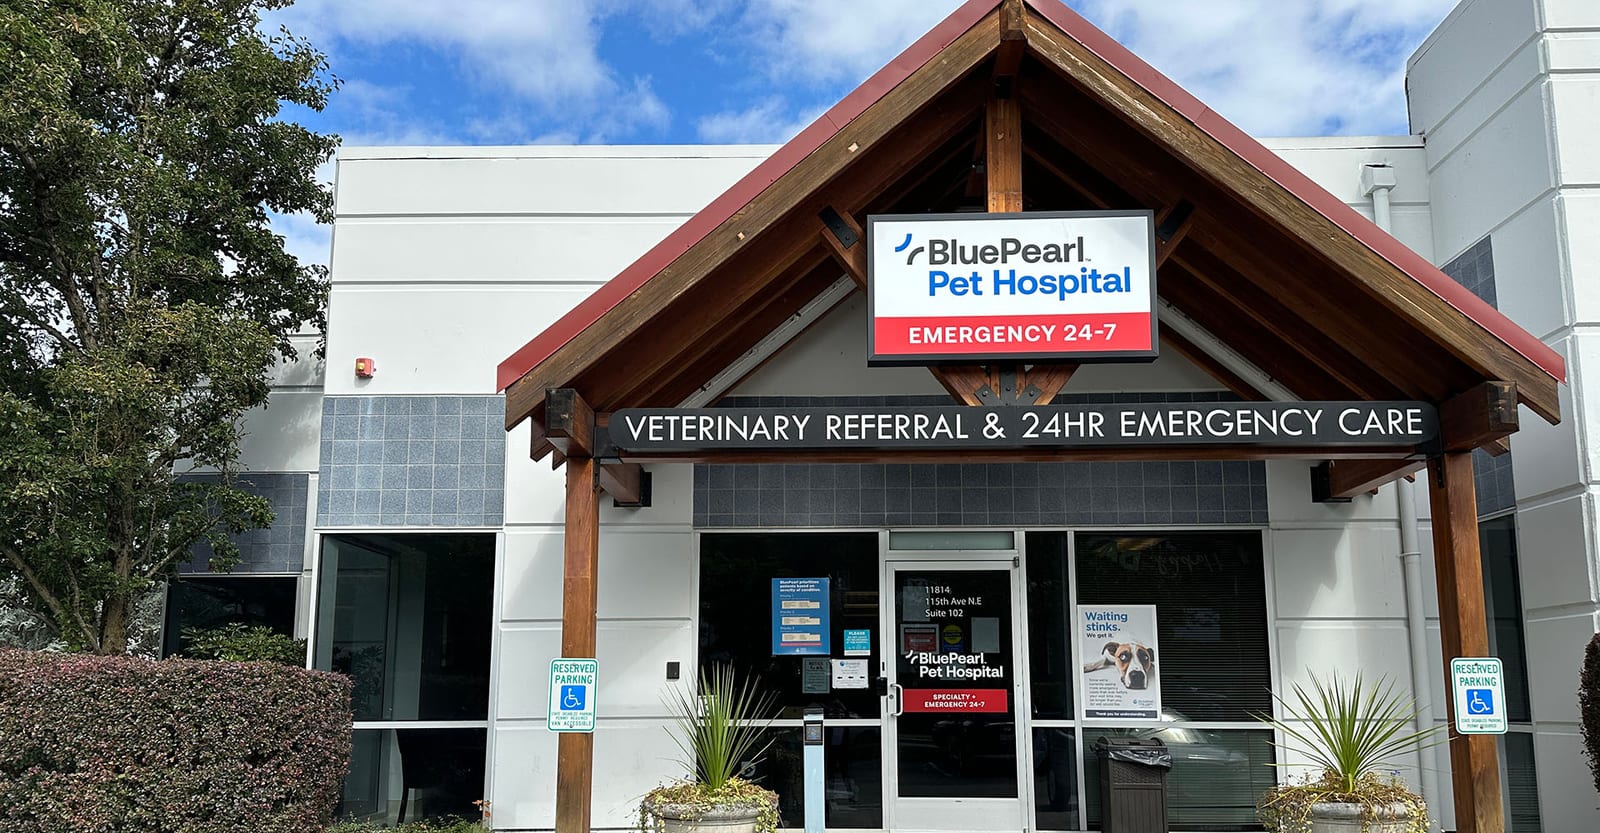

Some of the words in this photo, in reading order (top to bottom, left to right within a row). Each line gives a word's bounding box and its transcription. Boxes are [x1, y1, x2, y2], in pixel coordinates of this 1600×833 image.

[929, 236, 1084, 265] BluePearl
[929, 271, 983, 297] Pet
[993, 266, 1131, 301] Hospital
[909, 324, 1056, 344] EMERGENCY
[1063, 323, 1117, 342] 24-7
[625, 414, 811, 441] VETERINARY
[826, 413, 969, 440] REFERRAL
[982, 412, 1006, 440] &
[1021, 411, 1105, 439] 24HR
[1120, 408, 1323, 437] EMERGENCY
[1338, 408, 1423, 436] CARE
[925, 585, 950, 594] 11814
[925, 597, 949, 606] 115th
[950, 597, 967, 606] Ave
[925, 608, 947, 617] Suite
[949, 608, 964, 617] 102
[1085, 612, 1128, 623] Waiting
[1086, 622, 1121, 631] stinks.
[919, 652, 984, 665] BluePearl
[554, 664, 595, 673] RESERVED
[919, 666, 943, 678] Pet
[946, 665, 1004, 681] Hospital
[1456, 664, 1498, 674] RESERVED
[555, 675, 593, 684] PARKING
[1459, 677, 1497, 687] PARKING
[933, 693, 971, 701] SPECIALTY
